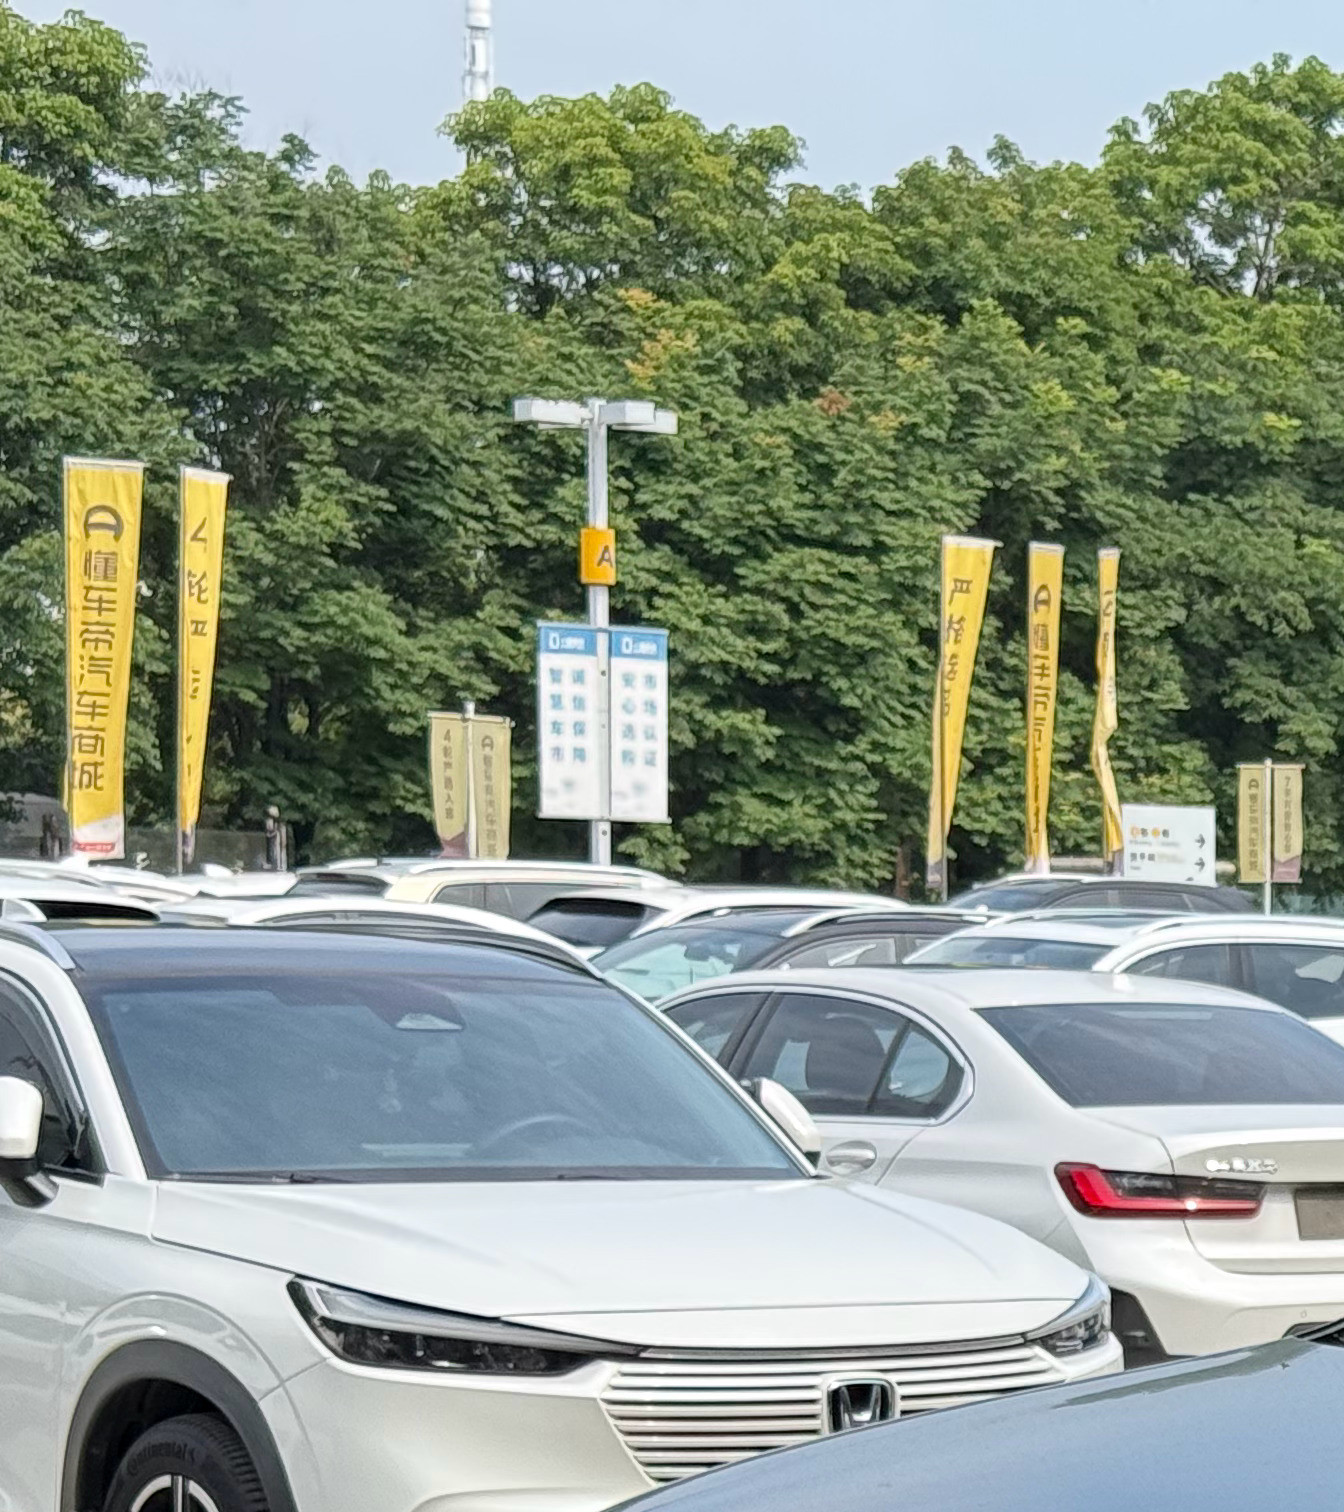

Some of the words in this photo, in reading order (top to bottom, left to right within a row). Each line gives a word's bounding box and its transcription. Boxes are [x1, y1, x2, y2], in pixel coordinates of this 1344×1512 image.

[597, 545, 614, 568] A
[72, 549, 117, 791] 懂车帝汽车商城
